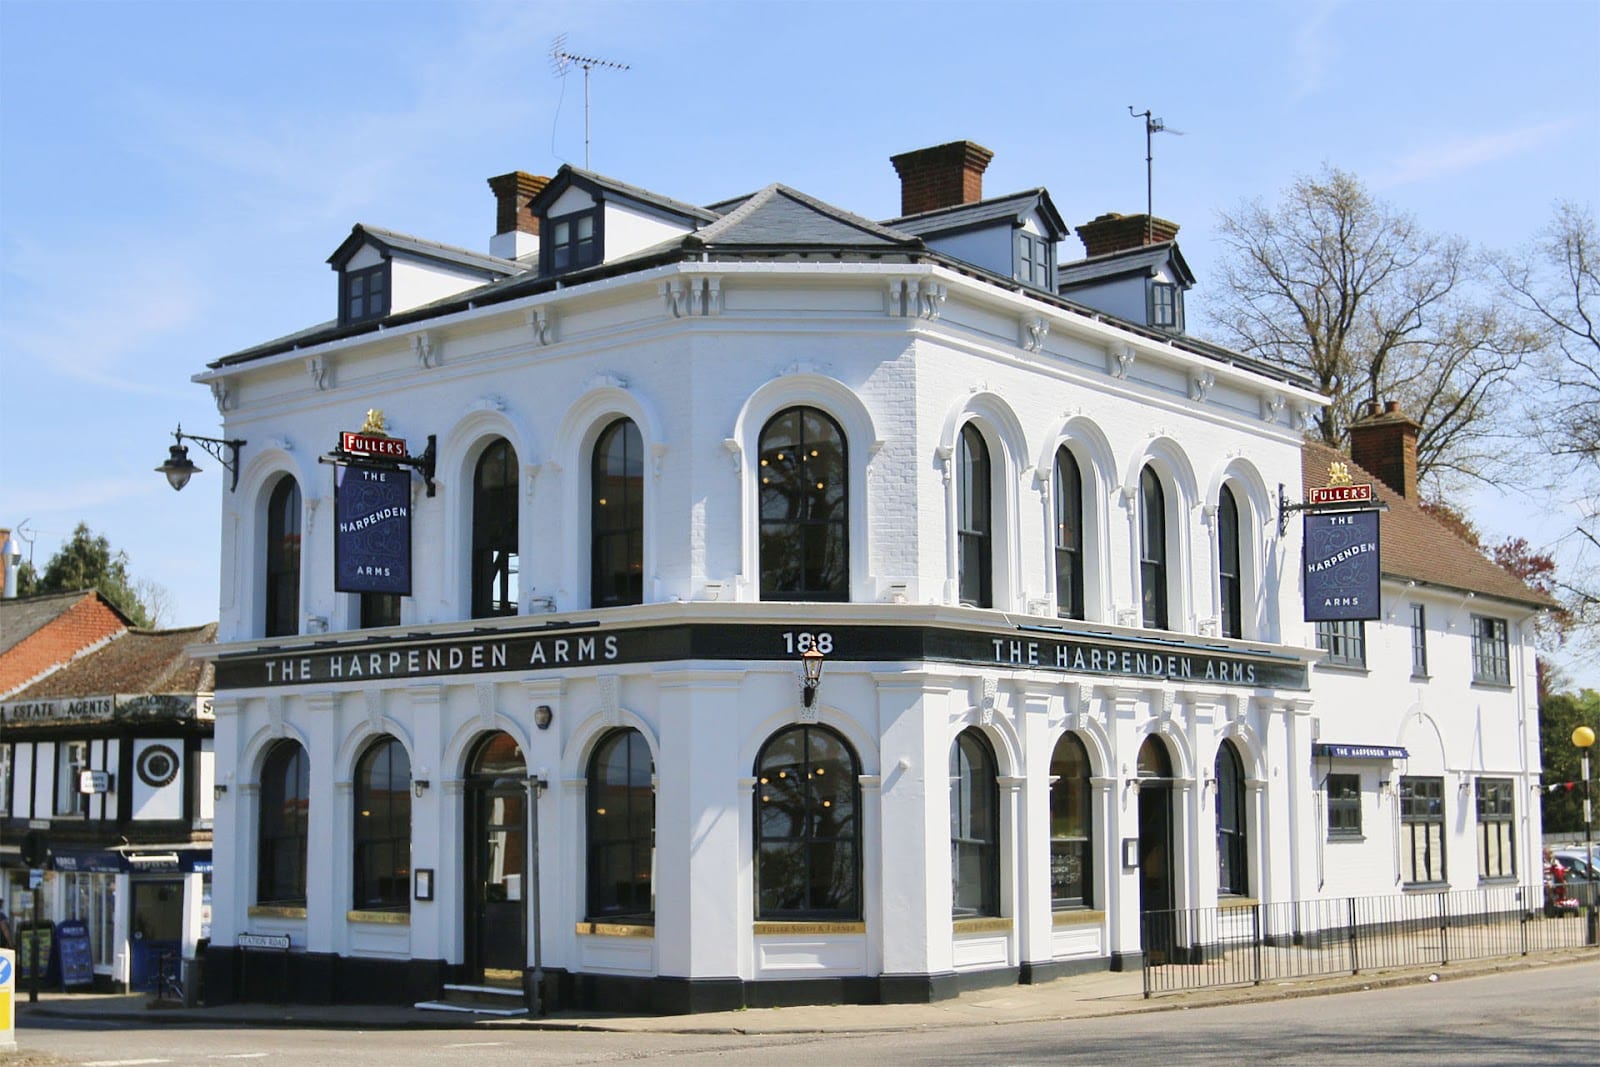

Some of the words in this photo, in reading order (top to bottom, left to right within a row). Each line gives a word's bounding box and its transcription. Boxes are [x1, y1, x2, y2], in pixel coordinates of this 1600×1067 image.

[347, 435, 403, 455] FULLER'S
[363, 471, 386, 482] THE
[1312, 487, 1367, 501] FULLER'S
[340, 507, 407, 533] HARPENDEN
[1330, 516, 1354, 525] THE
[1308, 543, 1376, 573] HARPENDEN
[356, 566, 390, 576] ARMS
[1324, 598, 1359, 607] ARMS
[782, 632, 834, 654] 188
[265, 658, 311, 682] THE
[330, 643, 506, 677] HARPENDEN
[530, 636, 618, 664] ARMS
[992, 639, 1039, 665] THE
[1056, 645, 1192, 678] HARPENDEN
[1205, 659, 1256, 683] ARMS
[14, 703, 55, 718] ESTATE
[67, 700, 111, 715] AGENTS
[1336, 747, 1348, 756] THE
[1351, 748, 1385, 757] HARPENDEN
[1388, 749, 1403, 757] ARMS
